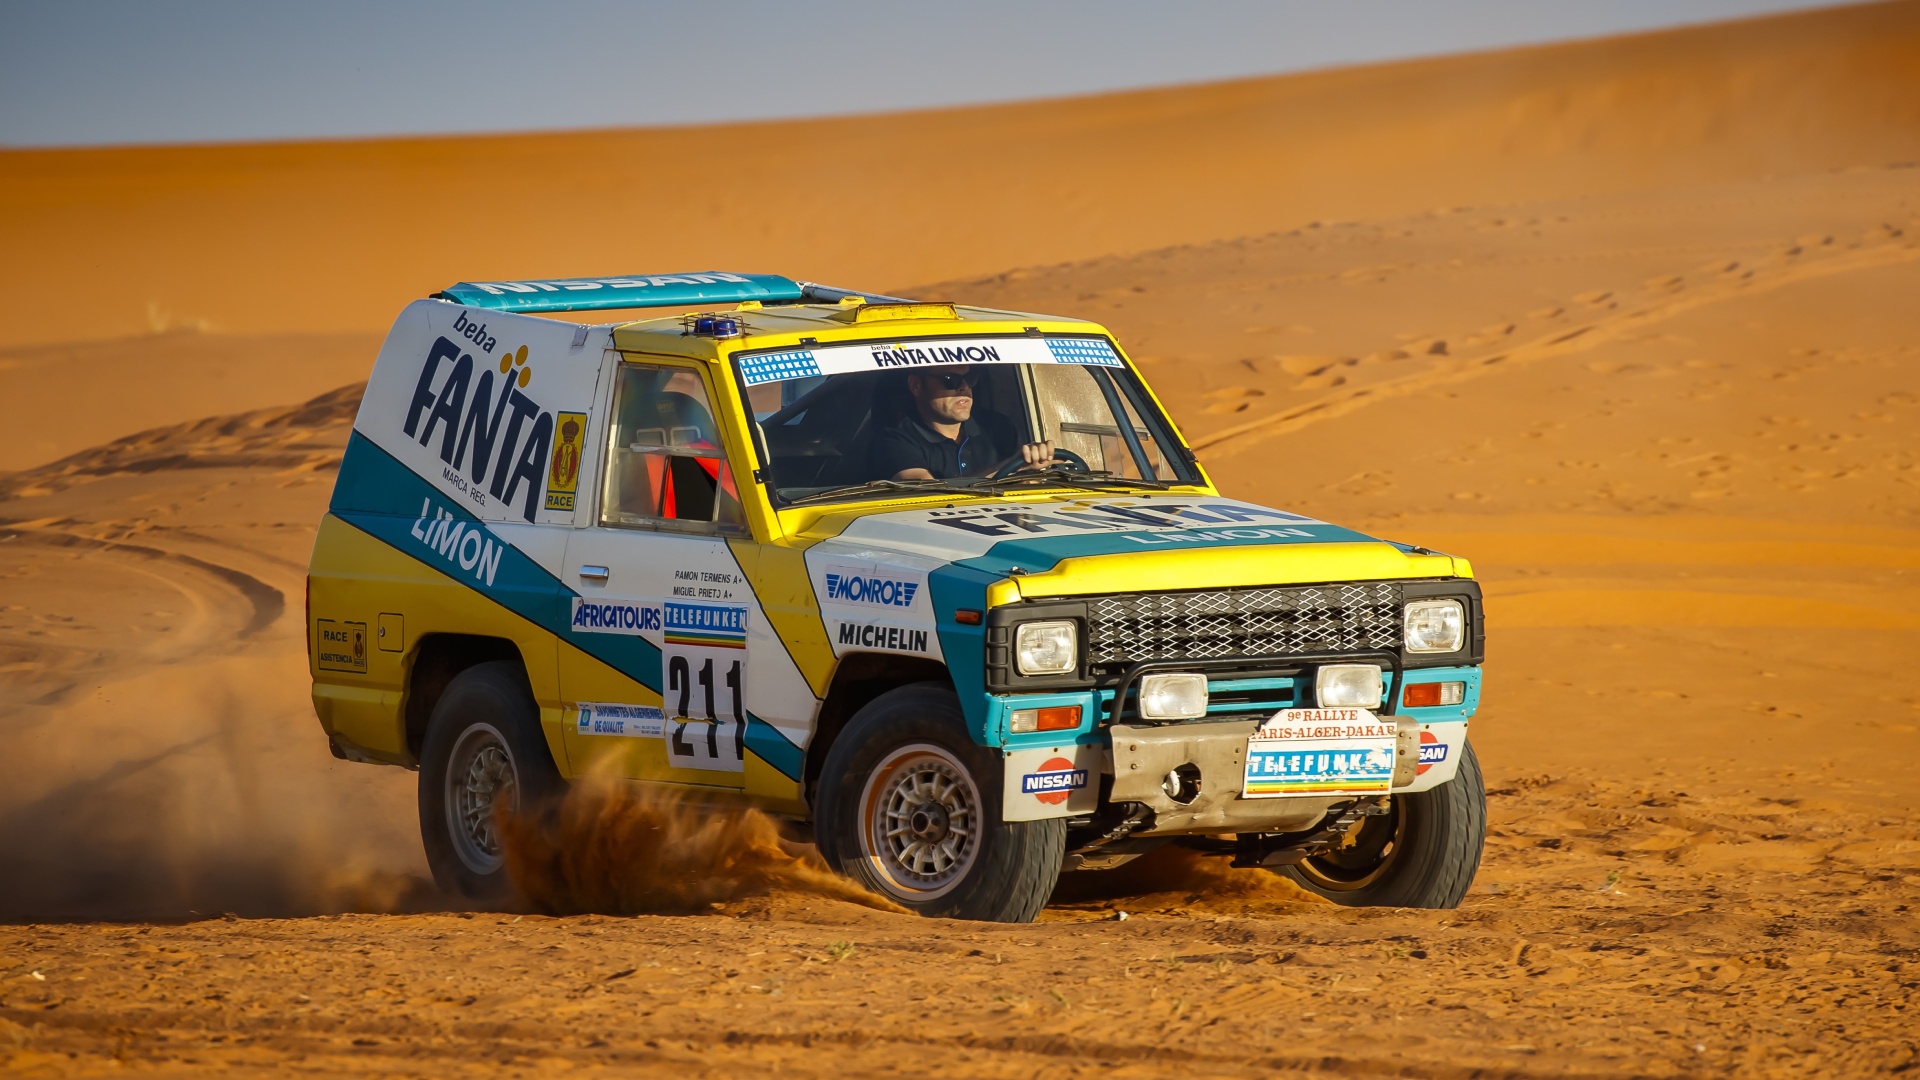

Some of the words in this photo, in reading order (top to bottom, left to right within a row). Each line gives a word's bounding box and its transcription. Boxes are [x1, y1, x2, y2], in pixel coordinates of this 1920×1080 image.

[473, 272, 751, 295] NISSAN
[453, 310, 497, 353] beba
[1046, 340, 1109, 349] TELEFUNKEN
[1051, 348, 1114, 357] TELEFUNKEN
[740, 352, 812, 366] TELEFUNKEN
[871, 347, 931, 367] FANTA
[928, 345, 1000, 363] LIMON
[1056, 356, 1119, 365] TELEFUNKEN
[744, 360, 816, 374] TELEFUNKEN
[748, 368, 820, 383] TELEFUNKEN
[403, 336, 554, 524] FANTA
[442, 467, 467, 494] MARCA
[470, 488, 486, 507] REG.
[547, 496, 573, 507] RACE
[928, 505, 1313, 536] FANTA
[411, 497, 503, 587] LIMON
[1121, 528, 1316, 544] LIMON
[675, 570, 698, 580] RAMON
[701, 572, 731, 583] TERMENS
[733, 575, 742, 584] A+
[673, 586, 696, 597] MIGUEL
[723, 590, 732, 599] A+
[835, 575, 904, 606] MONROE
[573, 603, 661, 630] AFRICATOURS
[665, 607, 747, 630] TELEFUNKEN
[323, 630, 348, 642] RACE
[839, 623, 928, 652] MICHELIN
[320, 653, 353, 664] ASISTENCIA
[669, 656, 744, 760] 211
[1303, 709, 1358, 721] RALLYE
[594, 721, 602, 733] DE
[602, 721, 624, 734] QUALITE
[1026, 773, 1084, 790] NISSAN
